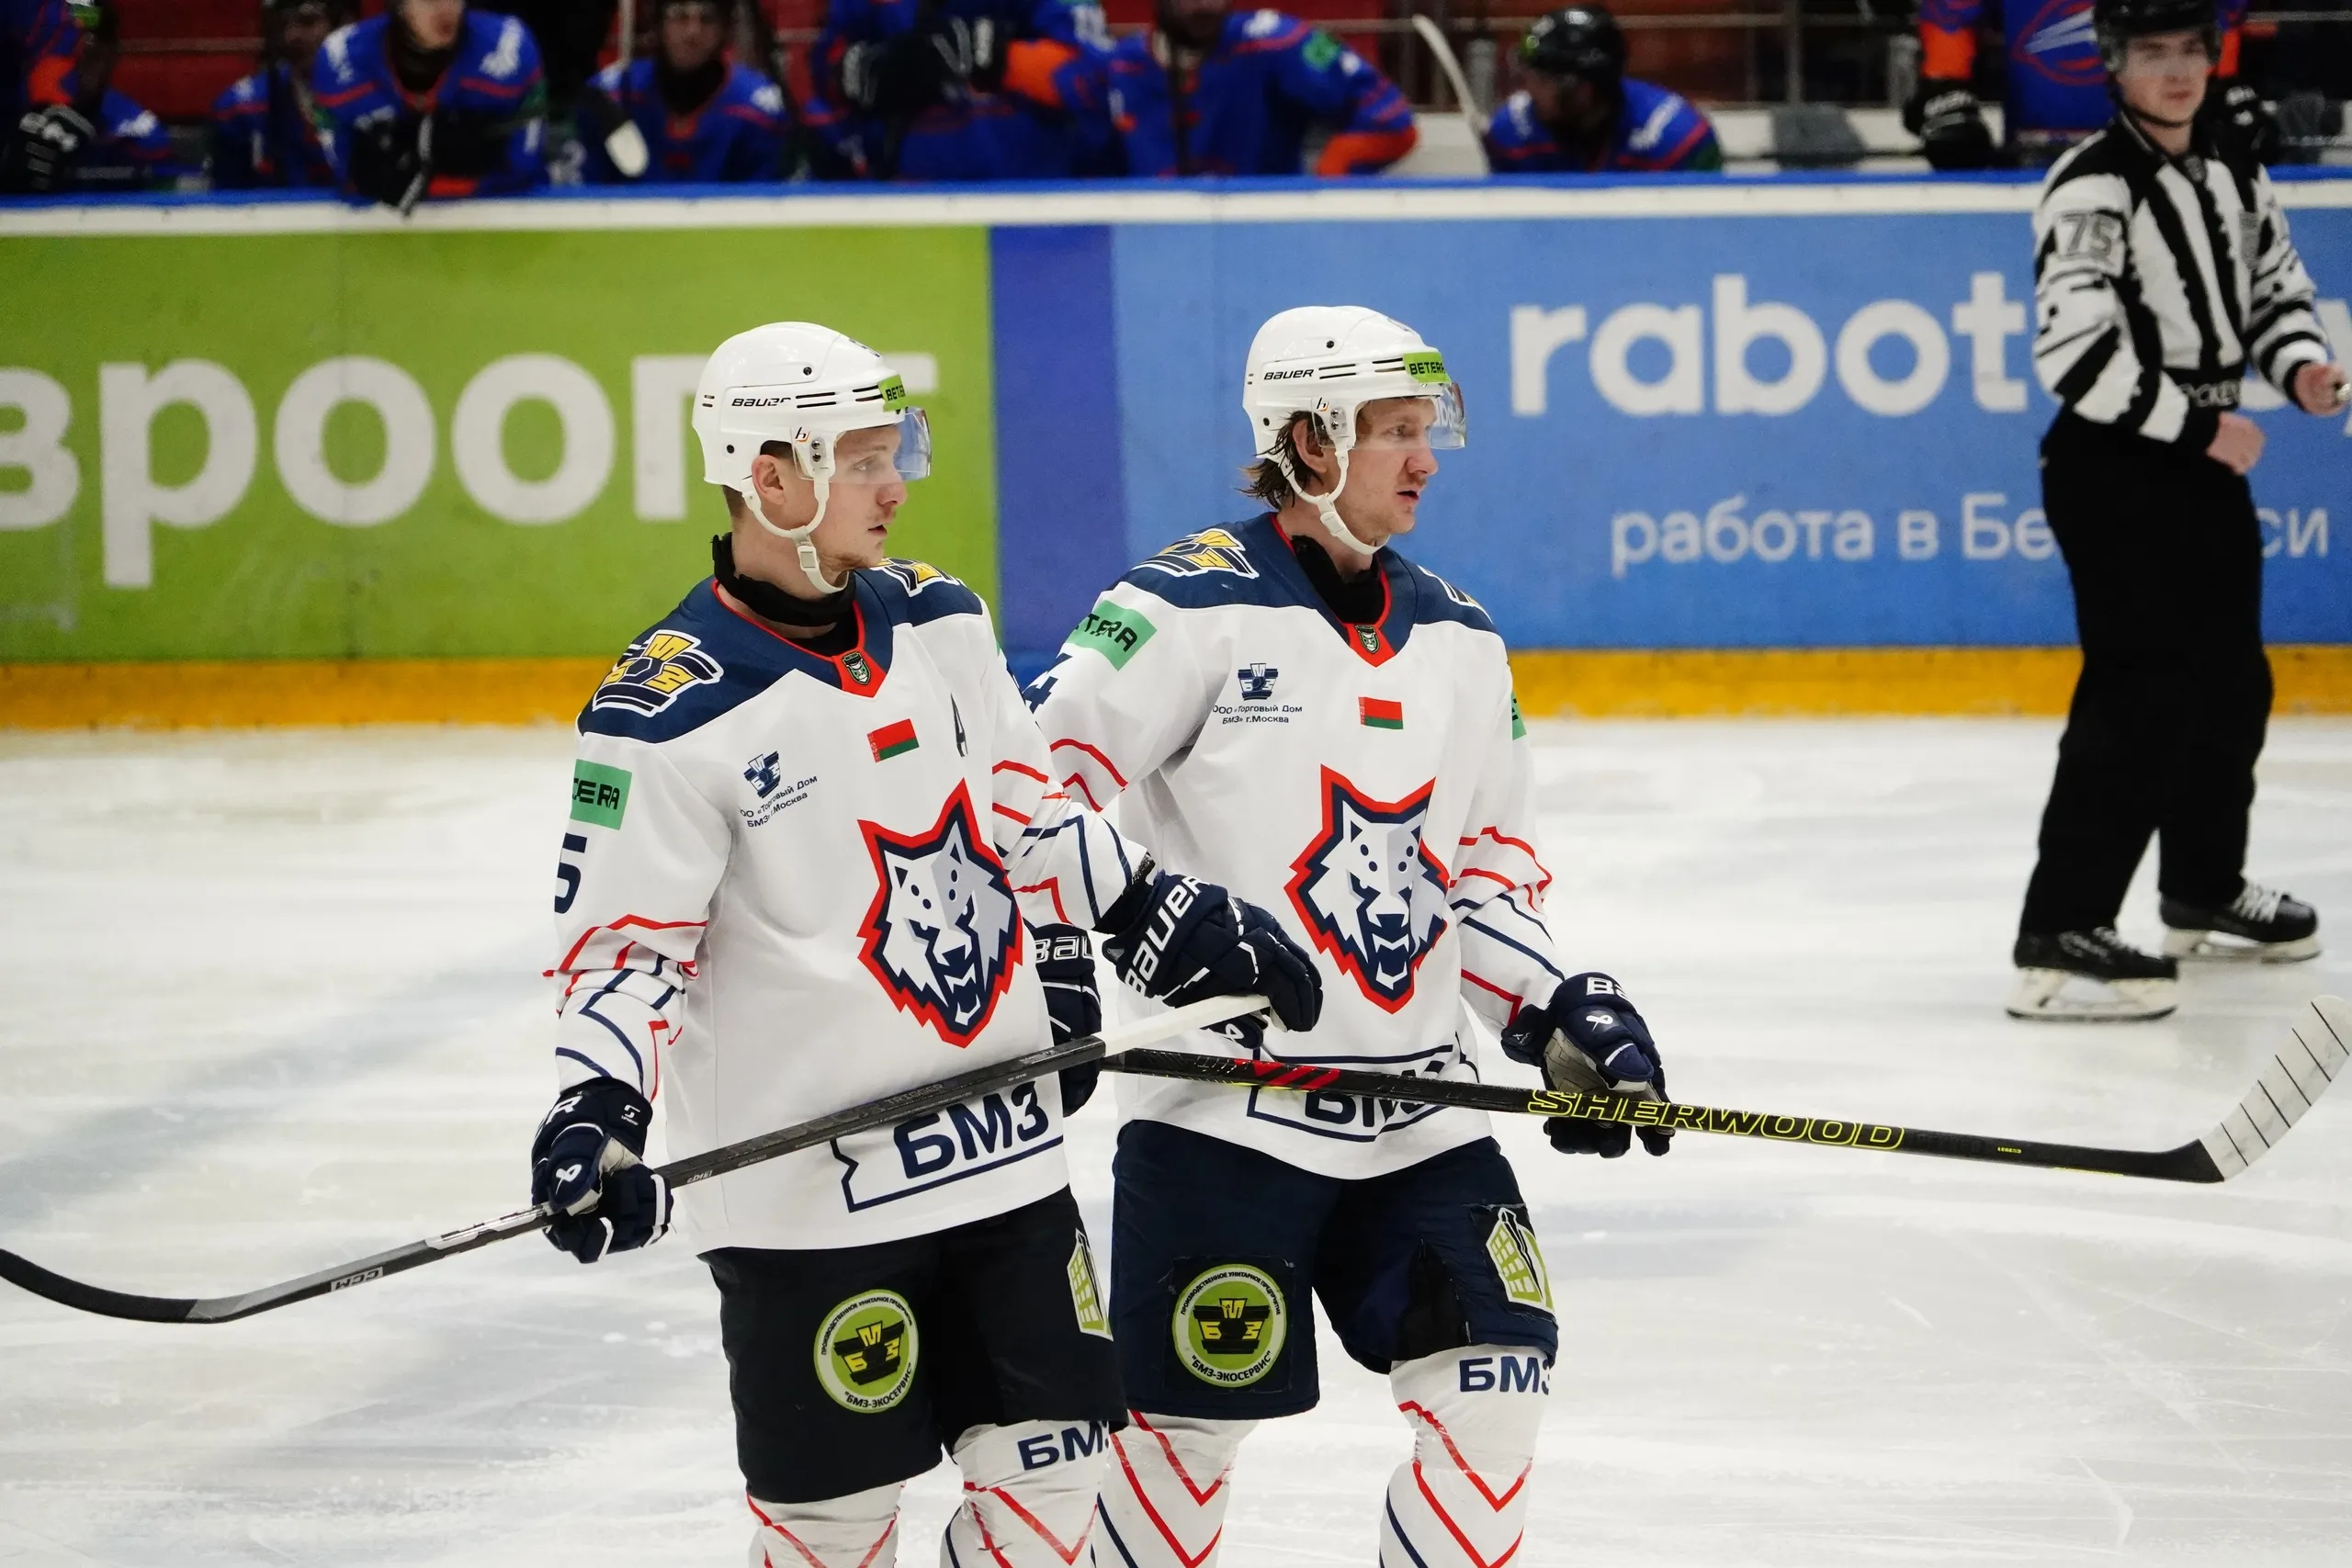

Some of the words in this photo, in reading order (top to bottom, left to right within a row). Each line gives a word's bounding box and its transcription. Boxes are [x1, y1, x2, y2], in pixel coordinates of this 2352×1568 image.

[2061, 212, 2120, 260] 75
[1264, 369, 1314, 380] BAUER
[1510, 271, 2352, 436] rabot
[1611, 492, 1873, 578] работа
[1899, 510, 1939, 558] в
[1075, 614, 1138, 652] TERA
[1282, 705, 1303, 714] Дом
[797, 776, 818, 790] Дом
[893, 1080, 1049, 1179] БМЗ
[1527, 1089, 1905, 1150] SHERWOOD
[334, 1269, 379, 1291] CCM
[1017, 1420, 1109, 1471] БМ
